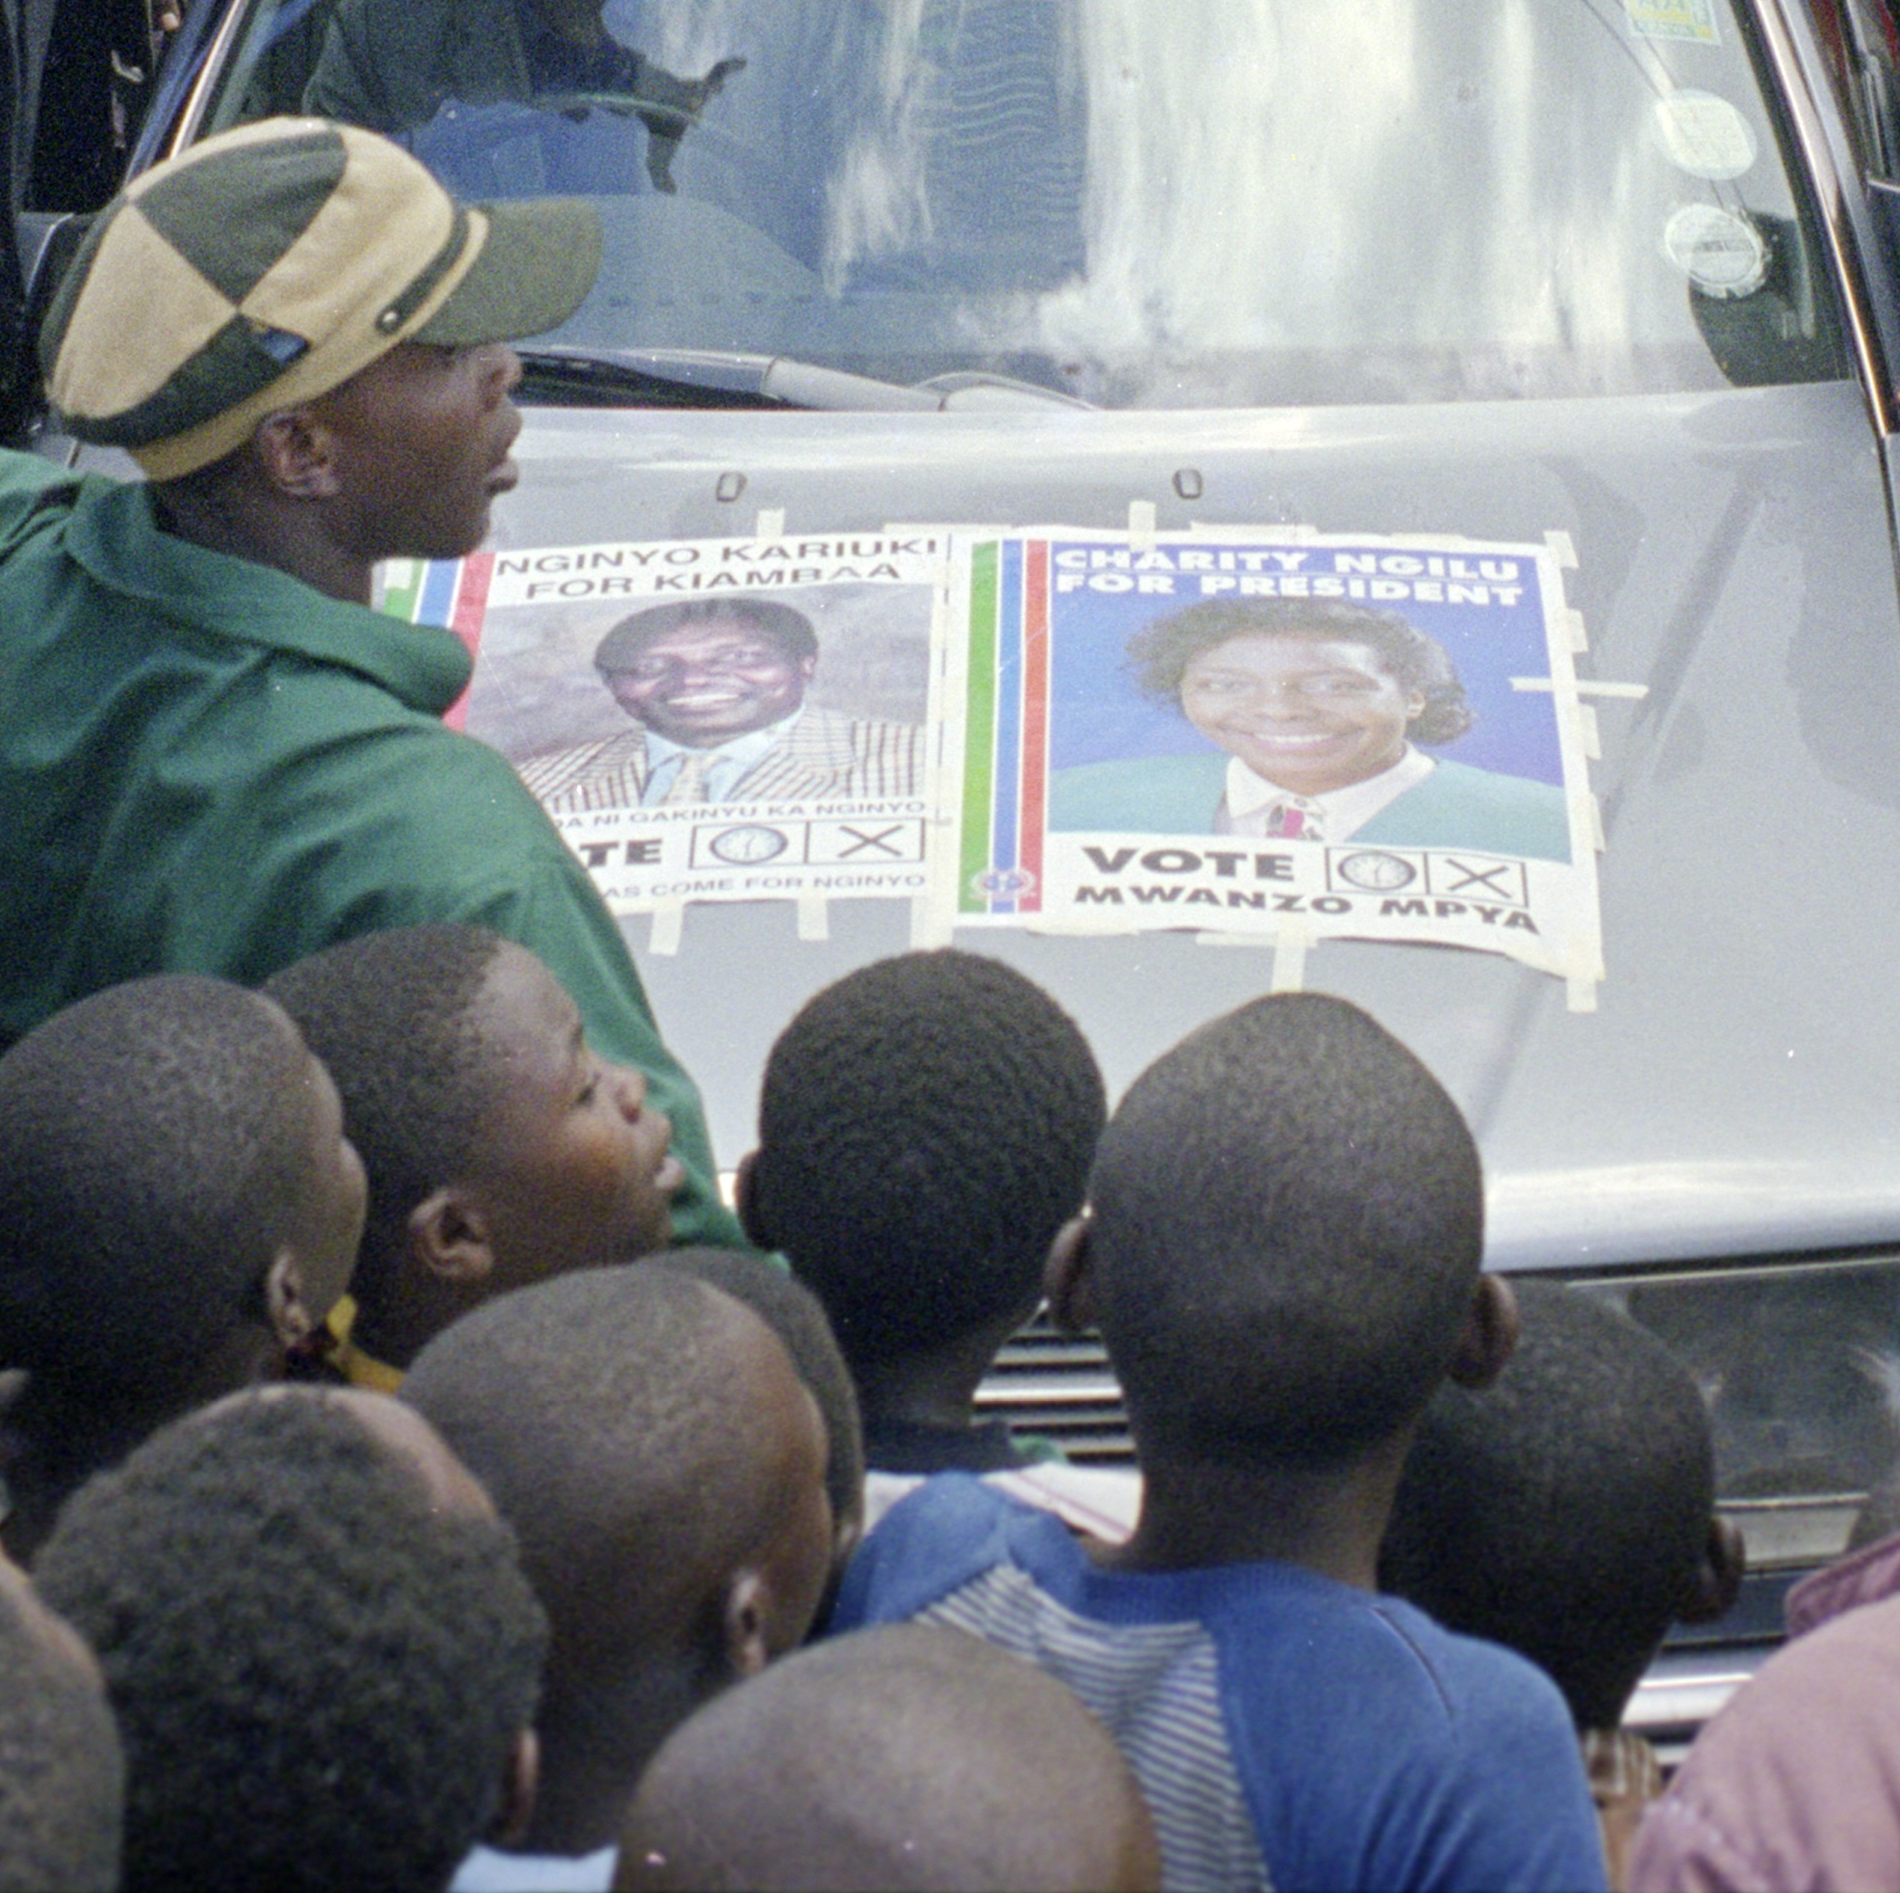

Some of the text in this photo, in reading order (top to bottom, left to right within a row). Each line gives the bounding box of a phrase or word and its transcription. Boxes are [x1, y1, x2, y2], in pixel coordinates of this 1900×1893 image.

[496, 538, 938, 577] NGINYO KARIUKI
[1054, 549, 1520, 583] CHARITY NGILU
[526, 562, 902, 600] FOR KIAMBAA
[1055, 573, 1524, 607] FOR PRESIDENT
[593, 814, 620, 826] NI
[767, 804, 805, 816] KA
[815, 800, 926, 814] NGINYO
[579, 838, 663, 868] TE
[1080, 846, 1296, 882] VOTE
[650, 878, 734, 897] COME
[744, 877, 804, 890] FOR
[813, 874, 926, 889] NGINYO
[1073, 885, 1541, 936] MWANZO MPYA
